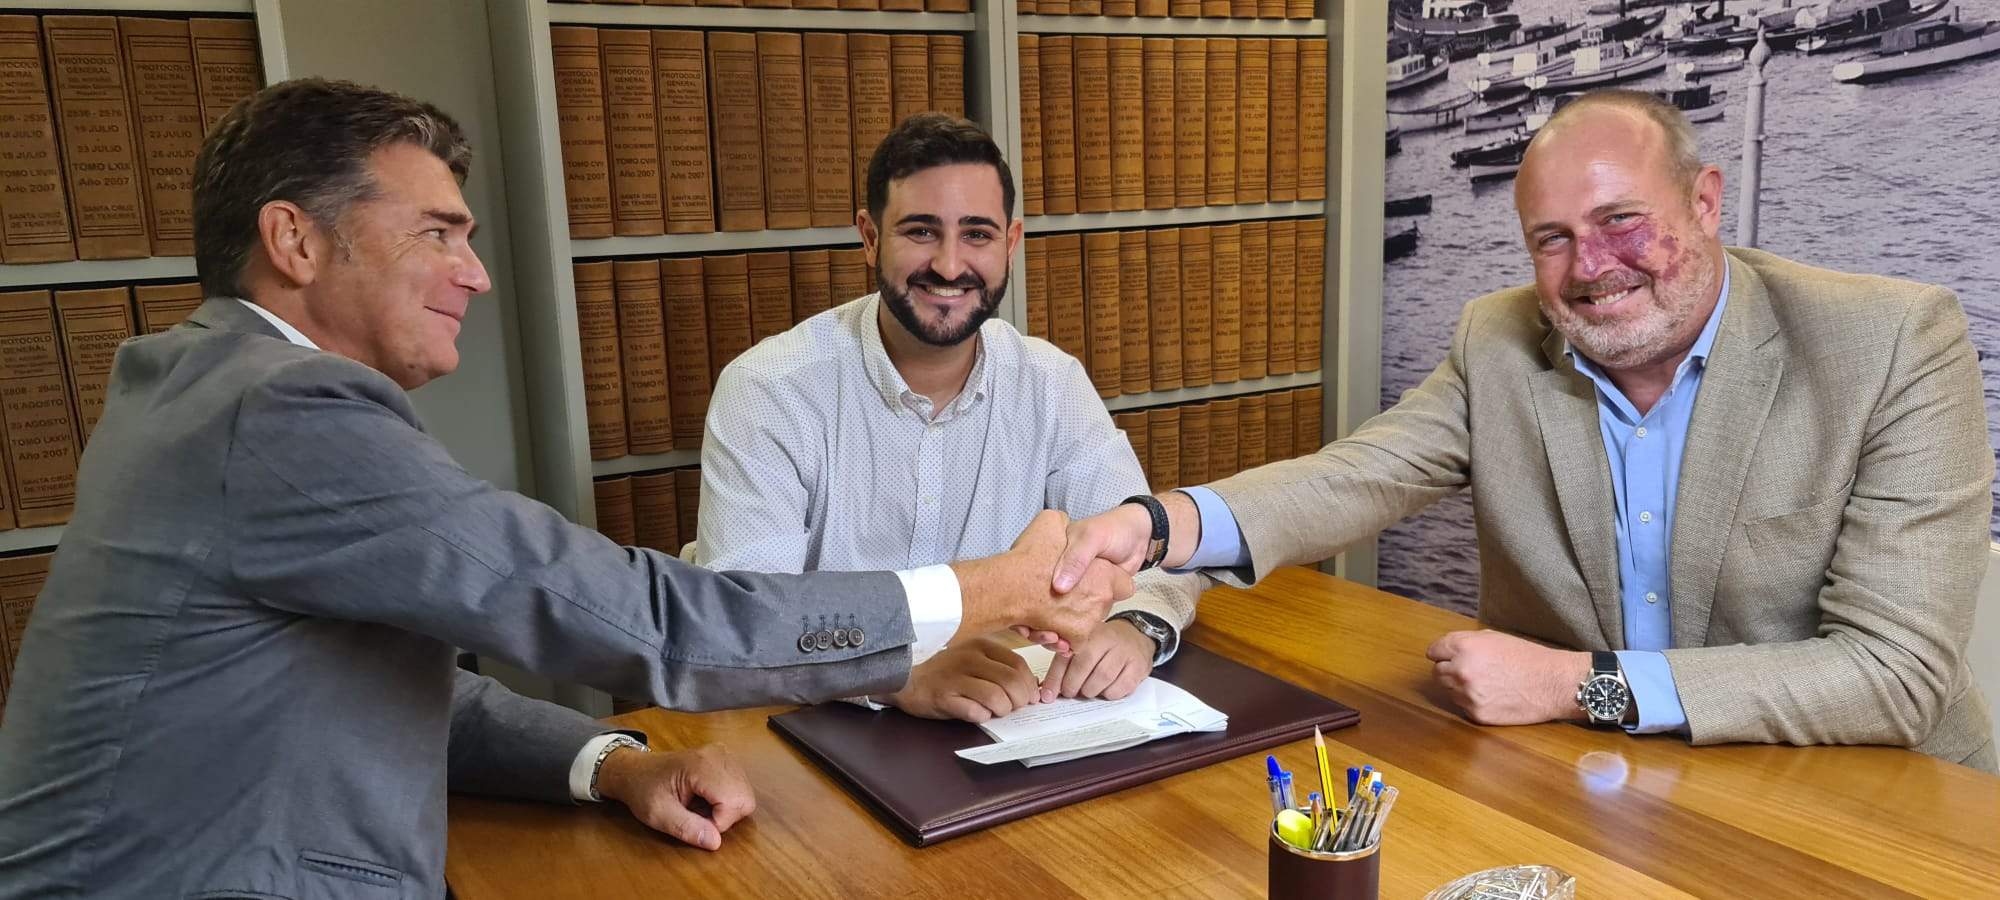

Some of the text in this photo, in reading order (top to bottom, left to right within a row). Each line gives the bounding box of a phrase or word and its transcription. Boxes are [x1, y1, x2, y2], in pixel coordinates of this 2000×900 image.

[58, 57, 115, 65] PROTOCOLO
[89, 125, 120, 133] JULIO
[13, 130, 44, 138] JULIO
[162, 130, 192, 138] JULIO
[92, 145, 122, 153] JULIO
[16, 151, 47, 159] JULIO
[166, 150, 195, 158] JULIO
[72, 163, 106, 171] TOMO
[150, 167, 183, 175] TOMO
[104, 178, 129, 186] 2007
[30, 183, 56, 192] 2007
[0, 335, 52, 344] ROTOCOLO
[72, 331, 126, 342] PROTOCOLO
[631, 381, 656, 389] TOMO
[22, 398, 64, 409] AGOSTO
[25, 417, 67, 428] AGOSTO
[12, 437, 41, 446] TOMO
[43, 448, 69, 459] 2007
